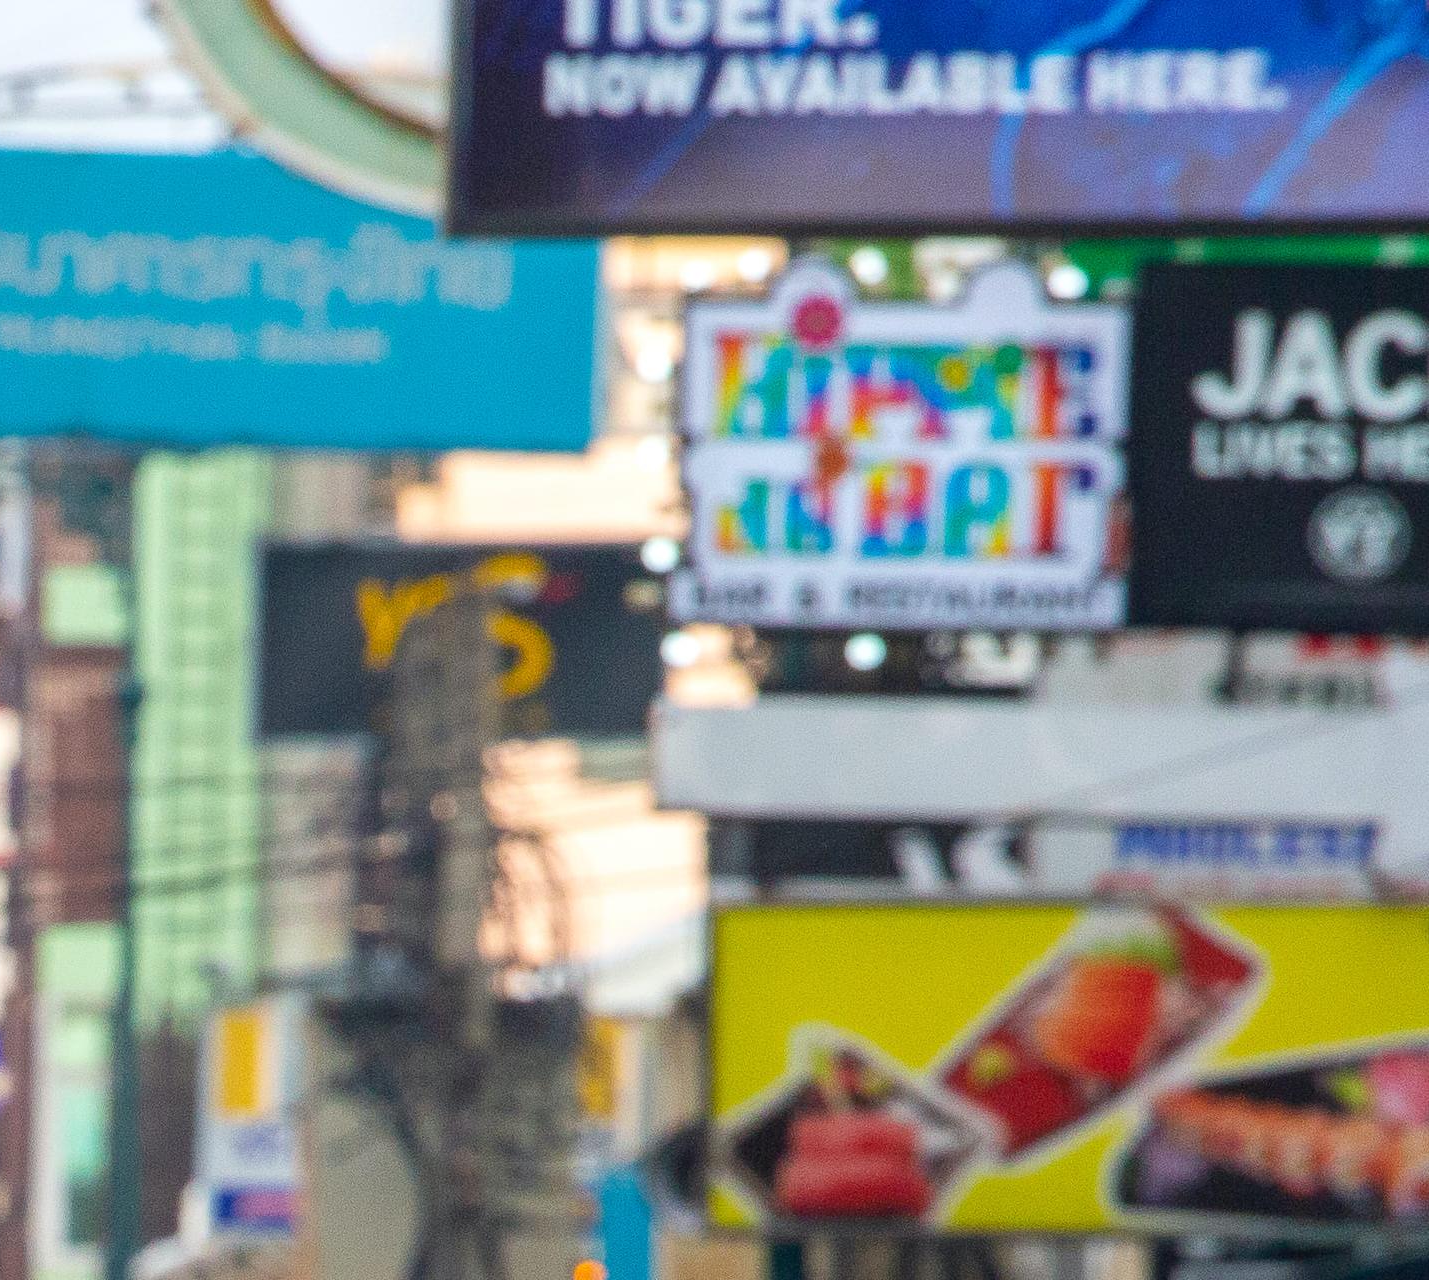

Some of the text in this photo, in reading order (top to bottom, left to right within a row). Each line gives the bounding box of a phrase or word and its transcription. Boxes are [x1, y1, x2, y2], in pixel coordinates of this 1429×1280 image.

[544, 48, 1289, 116] NOW AVAILABLE HERE.
[1194, 422, 1359, 480] LIVES
